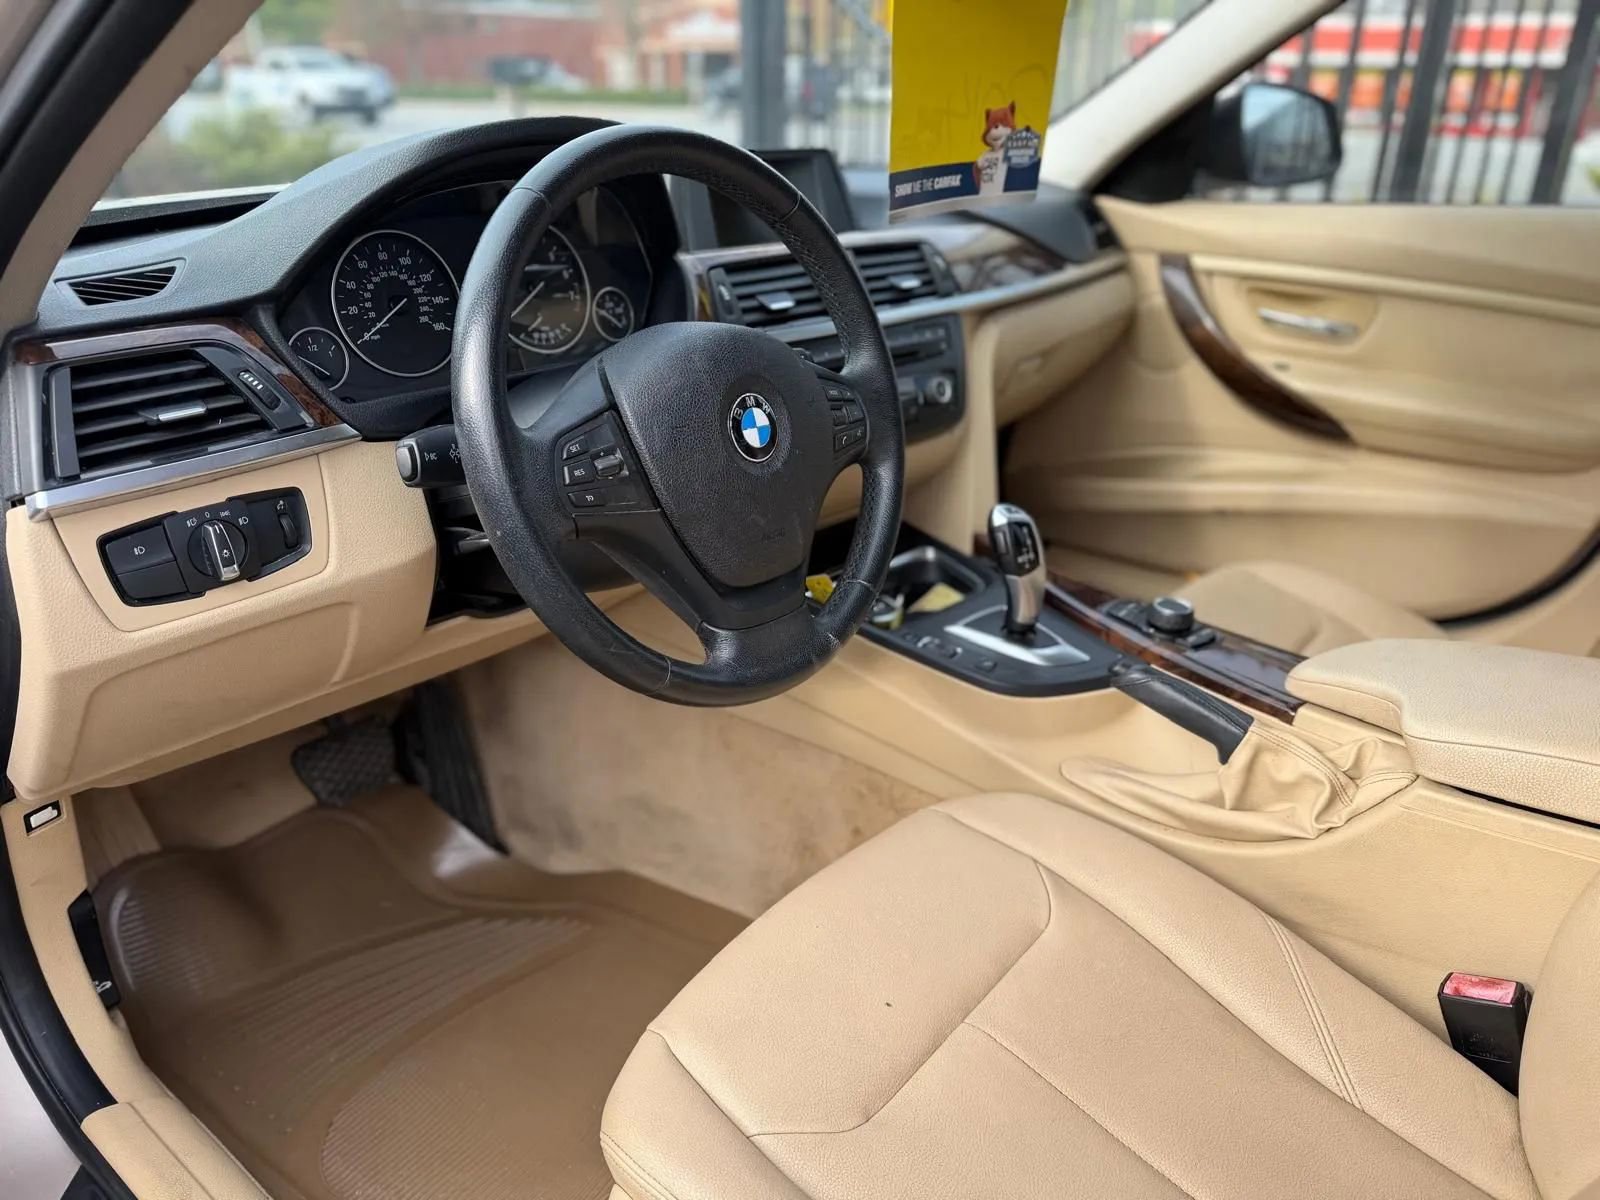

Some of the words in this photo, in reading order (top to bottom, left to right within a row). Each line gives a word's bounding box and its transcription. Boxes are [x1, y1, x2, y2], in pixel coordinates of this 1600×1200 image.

[895, 182, 913, 197] SHOW
[913, 180, 922, 192] ME
[922, 178, 933, 191] THE
[934, 174, 962, 189] CARFAX
[378, 251, 388, 260] 80
[357, 260, 368, 269] 60
[398, 256, 412, 265] 100
[419, 273, 432, 282] 120
[346, 280, 356, 289] 40
[431, 295, 444, 304] 140
[347, 305, 358, 315] 20
[432, 322, 445, 331] 160
[734, 396, 771, 420] BMW
[569, 443, 580, 453] SET
[573, 468, 586, 477] RES
